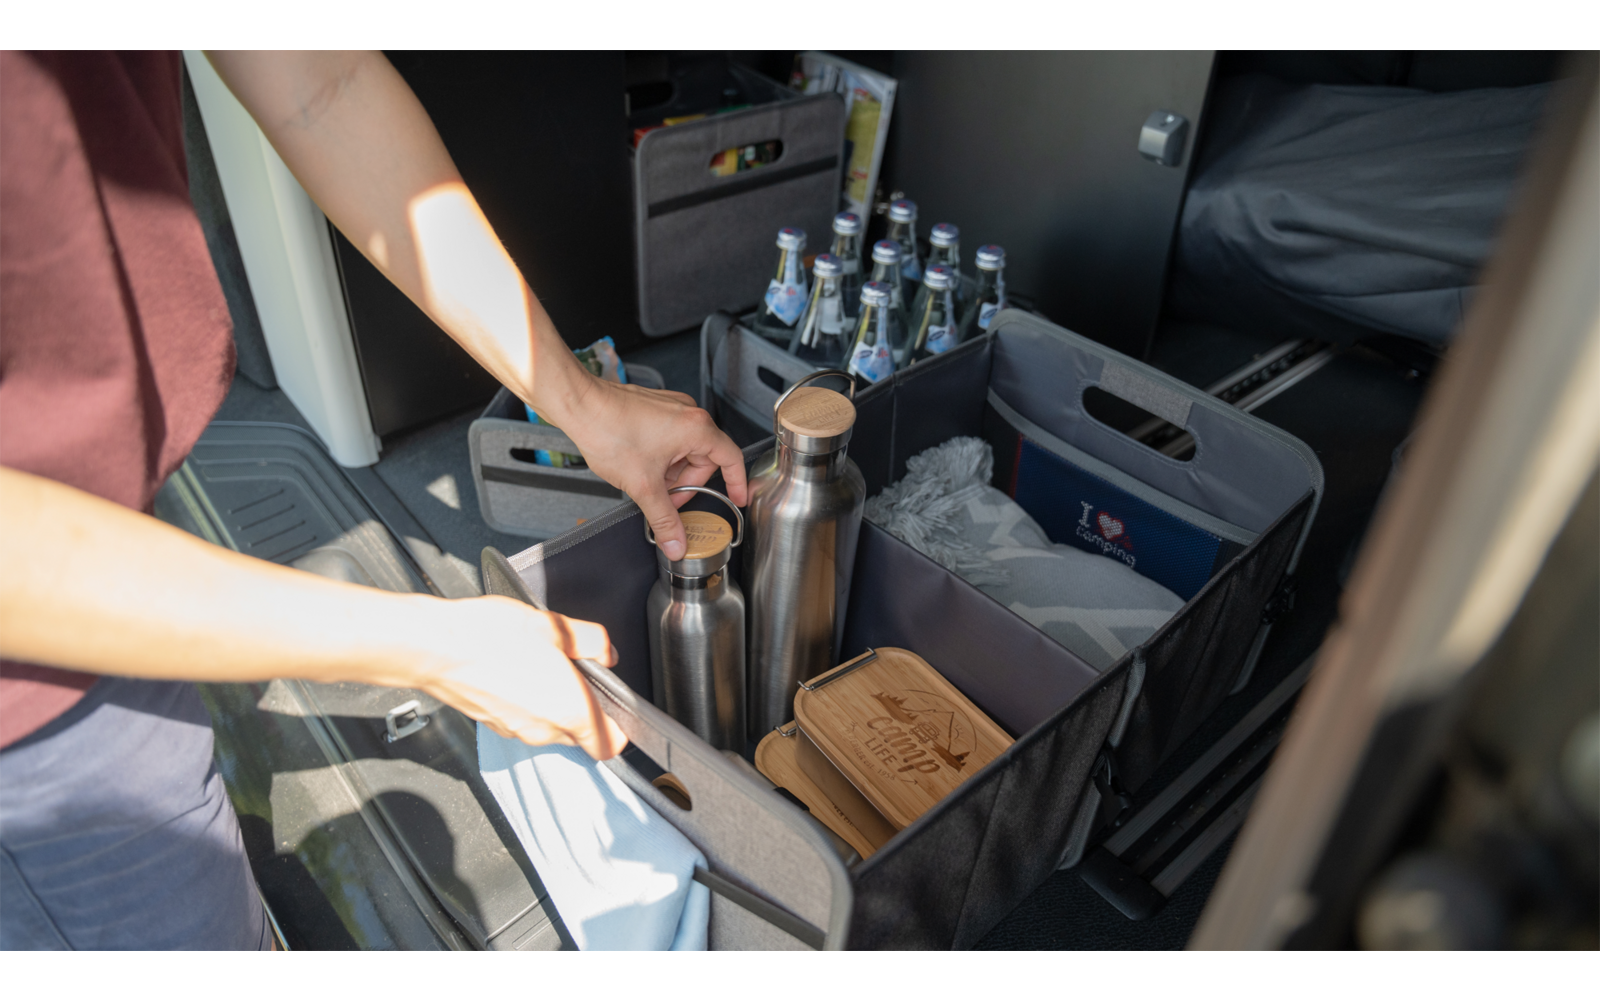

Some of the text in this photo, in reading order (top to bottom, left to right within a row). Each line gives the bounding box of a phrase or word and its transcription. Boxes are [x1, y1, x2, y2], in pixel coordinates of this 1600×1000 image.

[1078, 500, 1094, 528] I
[1075, 525, 1136, 568] camping
[864, 737, 898, 766] LIFE
